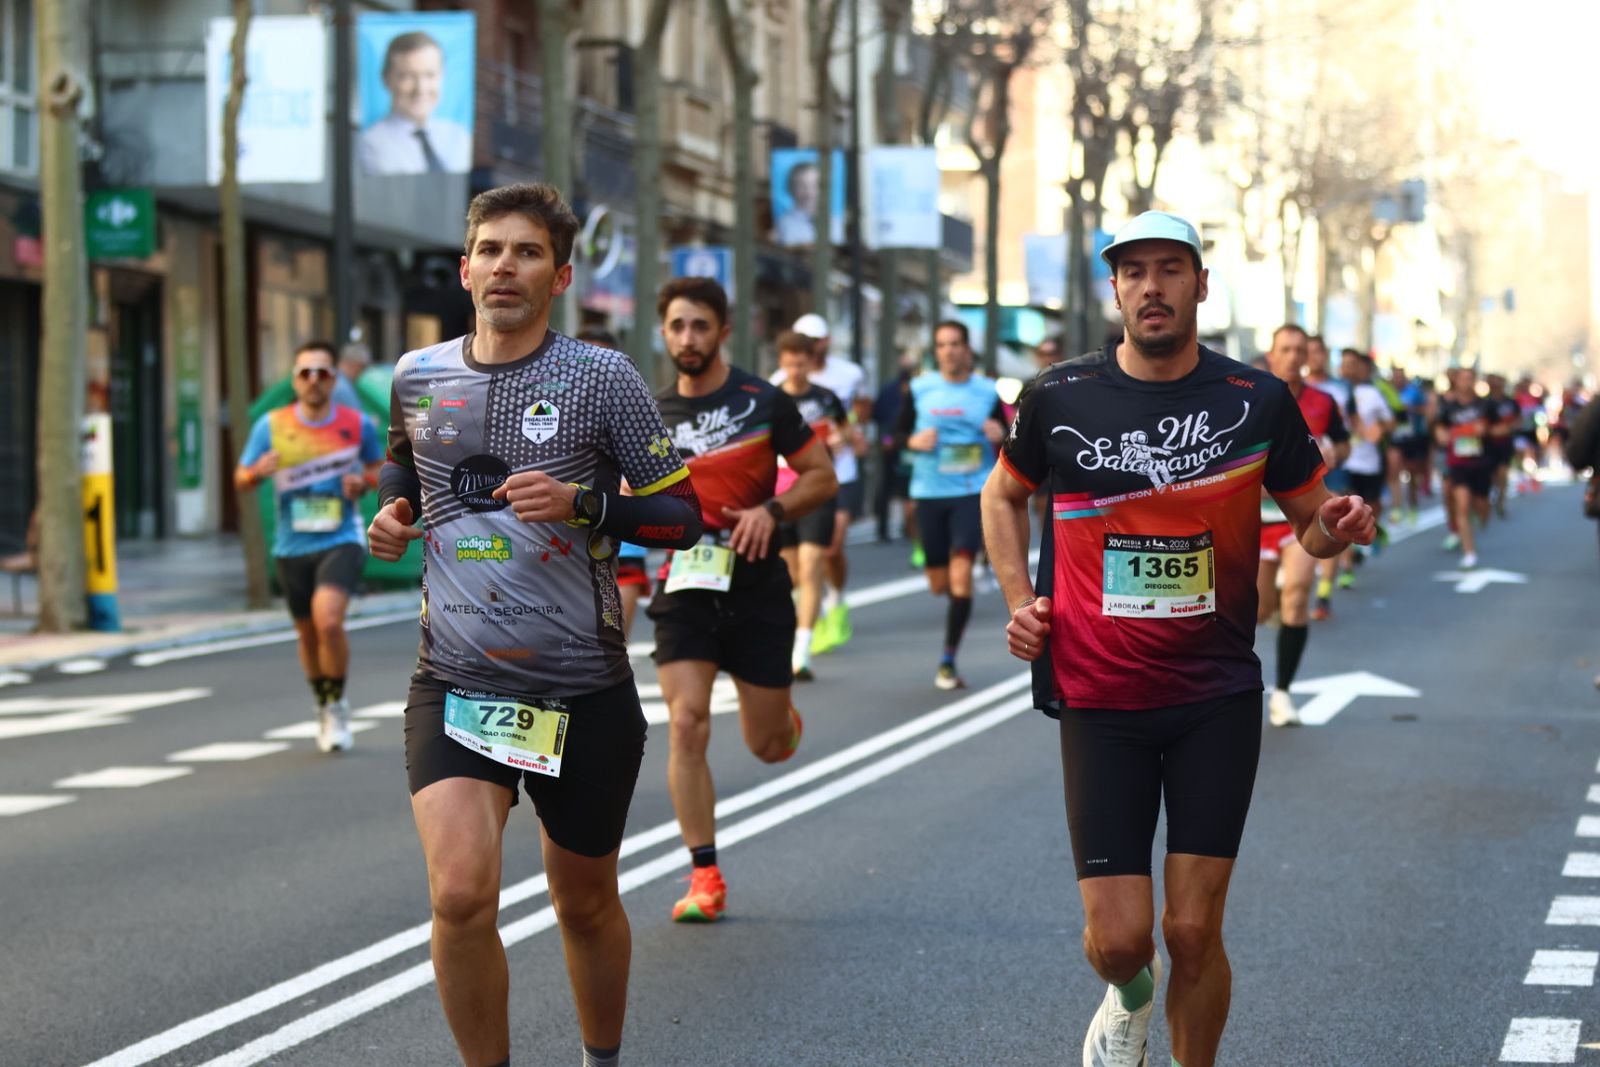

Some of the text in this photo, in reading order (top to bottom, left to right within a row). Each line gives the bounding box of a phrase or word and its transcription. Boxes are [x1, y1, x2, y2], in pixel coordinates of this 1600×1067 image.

[1076, 437, 1233, 473] Salamanca
[1094, 473, 1228, 507] CORRE CON LUZ PROPIA
[1169, 539, 1190, 548] 2026
[1128, 556, 1199, 578] 1365
[494, 603, 564, 617] SEQUEIRA
[1109, 602, 1140, 610] LABORAL
[478, 705, 535, 730] 729
[501, 731, 527, 742] GOMES
